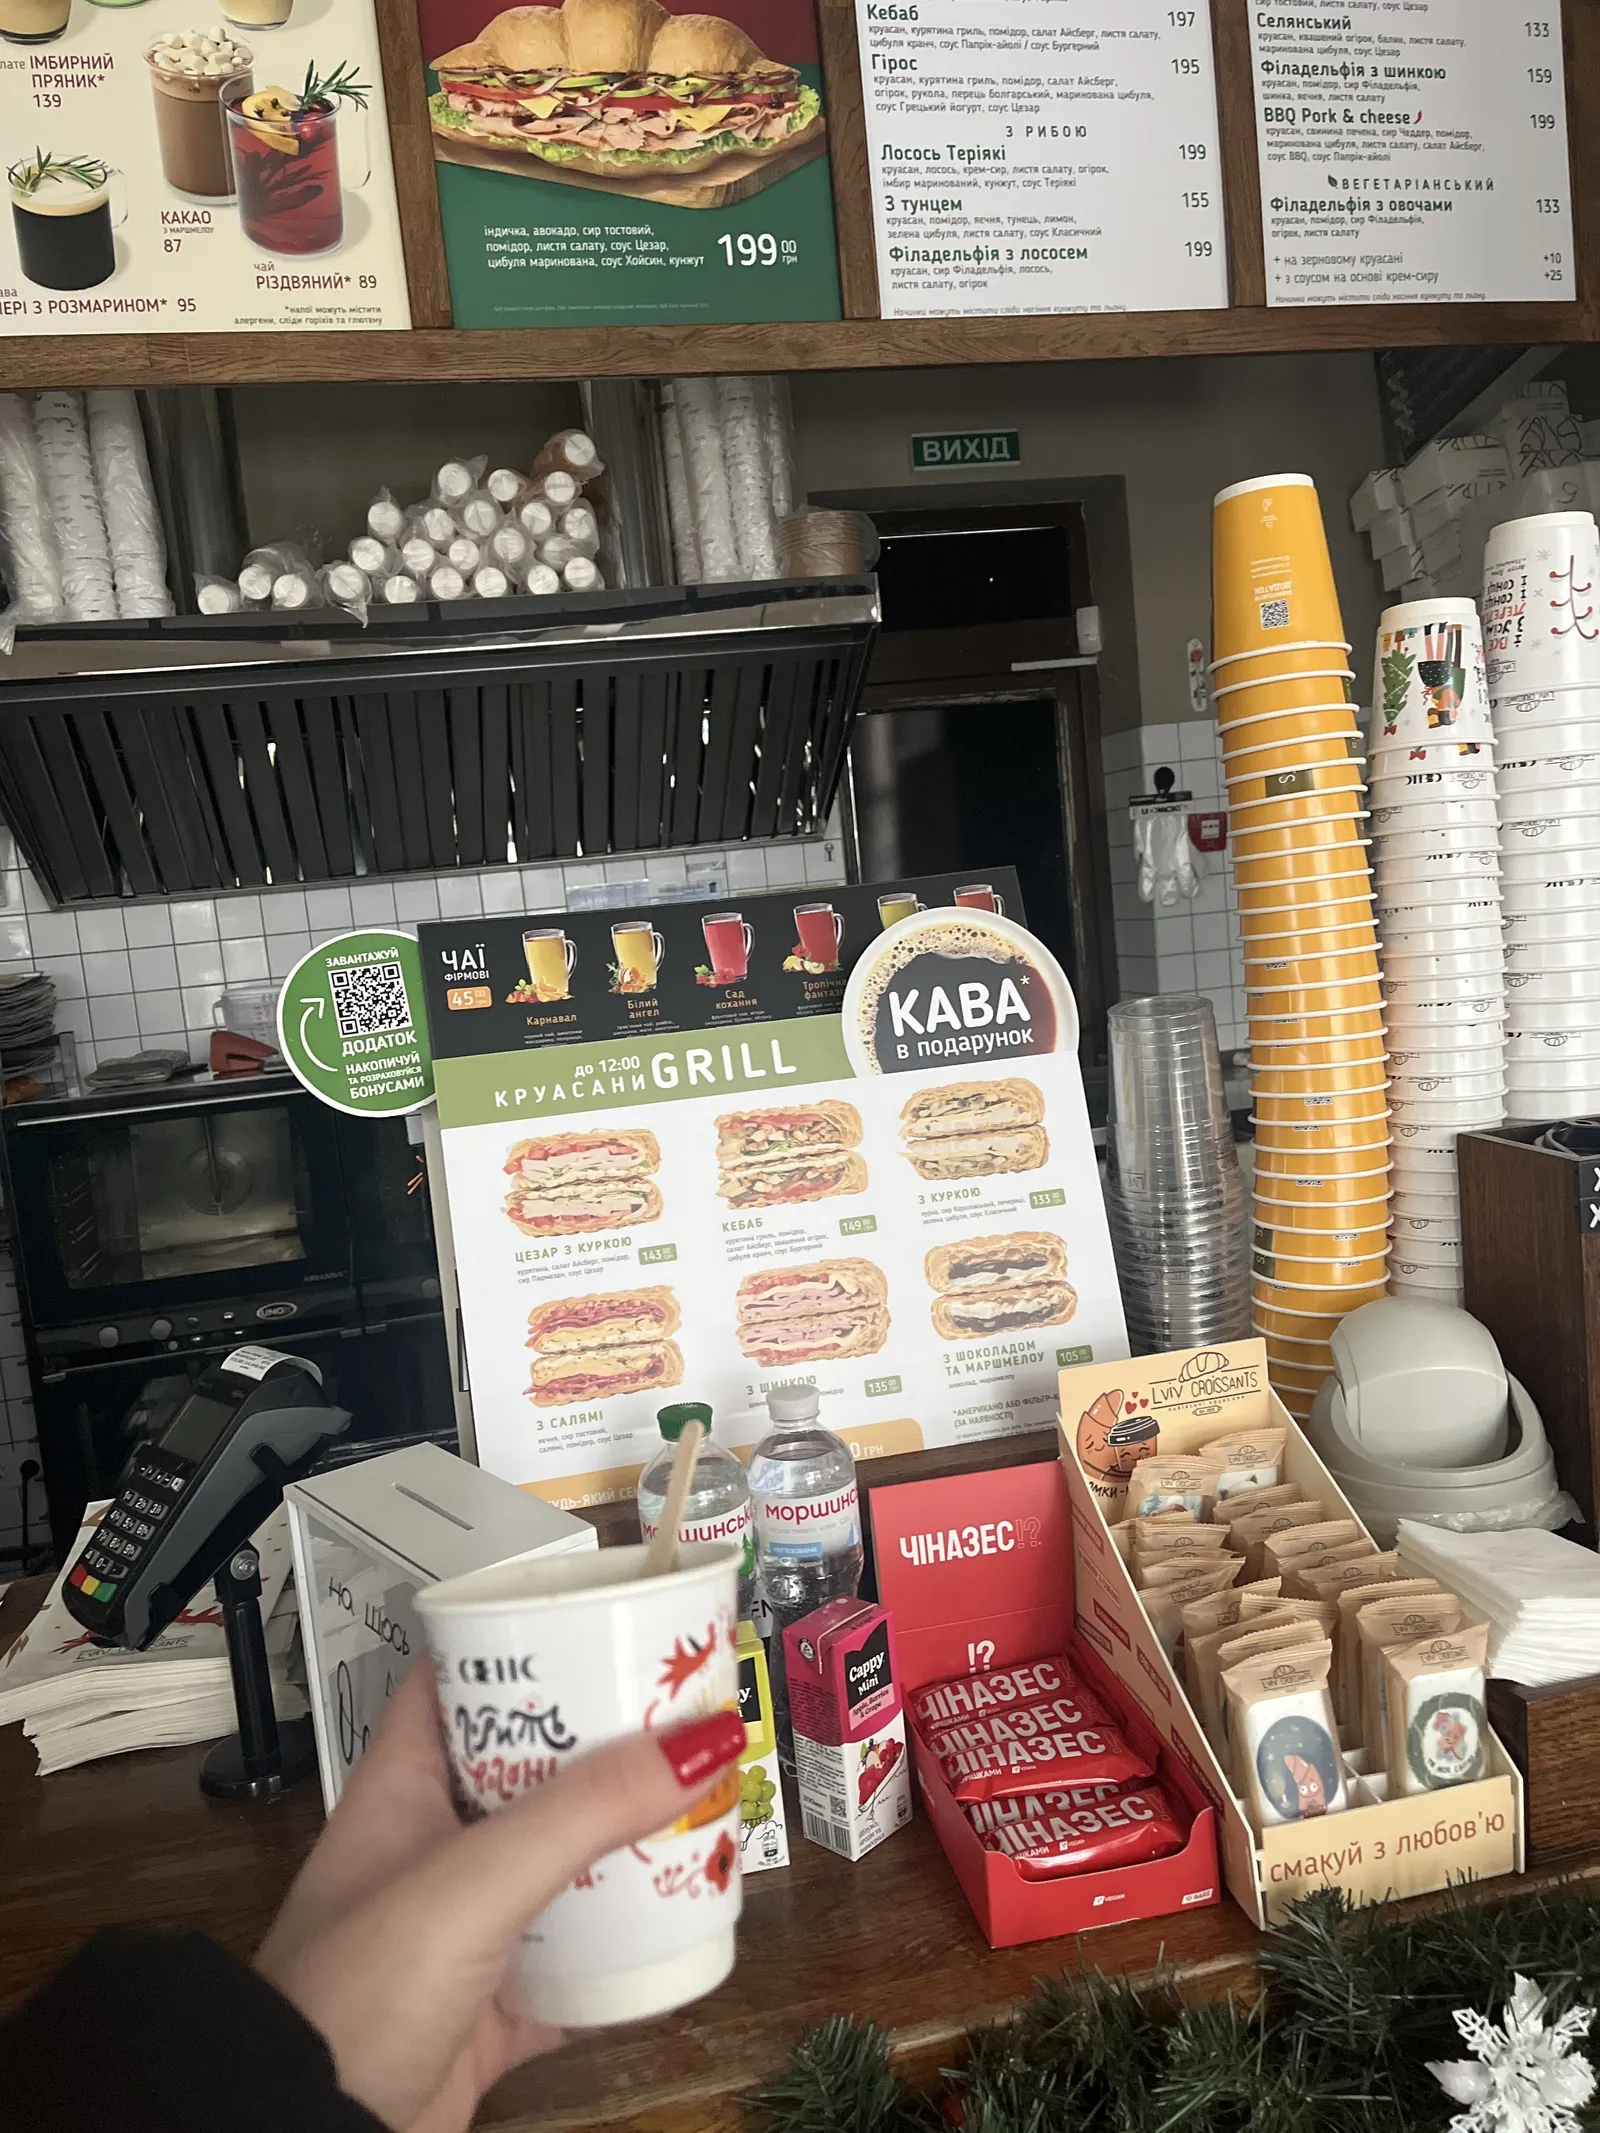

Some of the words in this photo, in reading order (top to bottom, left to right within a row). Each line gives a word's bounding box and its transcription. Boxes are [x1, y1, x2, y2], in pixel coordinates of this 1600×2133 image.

[867, 5, 919, 21] Кебаб
[1167, 11, 1196, 26] 197
[1256, 12, 1352, 30] Селянський
[868, 25, 908, 38] круасан,
[910, 26, 954, 37] курятина
[956, 27, 986, 37] гриль,
[988, 26, 1029, 40] помідор,
[1031, 28, 1056, 36] салат
[1059, 27, 1098, 39] Айсберг,
[1100, 30, 1126, 38] листя
[1128, 30, 1160, 41] салату,
[1524, 22, 1550, 38] 133
[30, 52, 114, 70] ІМБИРНИЙ
[872, 54, 919, 74] Гірос
[1171, 58, 1200, 74] 195
[1260, 60, 1364, 80] Філадельфія
[1370, 66, 1378, 78] з
[1384, 66, 1446, 80] шинкою
[1527, 68, 1552, 84] 159
[873, 75, 915, 86] круасан,
[918, 76, 964, 86] курятина
[966, 77, 998, 87] гриль,
[1001, 75, 1044, 88] помідор,
[1046, 77, 1074, 86] салат
[1077, 75, 1118, 88] Айсберг,
[33, 94, 62, 108] 139
[1264, 107, 1296, 126] BBQ
[1302, 108, 1337, 124] Pork
[1342, 109, 1354, 124] &
[1360, 109, 1411, 124] cheese
[1530, 114, 1556, 130] 199
[1006, 126, 1013, 138] З
[1026, 126, 1088, 138] РИБОЮ
[882, 144, 942, 161] Лосось
[946, 144, 1006, 164] Теріякі
[1178, 144, 1206, 160] 199
[1342, 177, 1495, 191] ВЕГЕТАРІАНСЬКИЙ
[884, 196, 894, 212] З
[900, 197, 963, 214] тунцем
[1182, 192, 1210, 208] 155
[1270, 196, 1371, 216] Філадельфія
[1376, 200, 1384, 212] з
[1389, 200, 1453, 212] овочами
[1536, 199, 1560, 214] 133
[160, 210, 212, 225] КАКАО
[484, 224, 529, 238] індичка,
[532, 226, 579, 237] авокадо,
[582, 226, 601, 238] сир
[604, 224, 654, 236] тостовий,
[164, 239, 182, 252] 87
[486, 240, 532, 254] помідор,
[536, 242, 566, 251] листя
[569, 242, 607, 253] салату,
[610, 241, 632, 253] соус
[634, 239, 668, 252] Цезар,
[717, 233, 778, 266] 199
[781, 240, 797, 254] 00
[1184, 242, 1212, 257] 199
[487, 255, 526, 269] цибуля
[529, 257, 598, 269] маринована,
[600, 256, 622, 268] соус
[625, 254, 666, 266] Хойсин,
[668, 256, 704, 268] кунжут
[782, 254, 798, 264] грн
[889, 246, 1000, 266] Філадельфія
[1006, 248, 1014, 260] з
[1020, 246, 1088, 260] лососем
[1544, 252, 1562, 264] +10
[254, 260, 275, 272] чай
[358, 274, 378, 289] 89
[176, 298, 197, 312] 95
[922, 436, 1010, 462] ВИХІД
[324, 946, 400, 968] ЗАВАНТАЖУЙ
[441, 943, 487, 971] ЧАЇ
[444, 970, 490, 983] ФІРМОВІ
[452, 990, 474, 1008] 45
[725, 990, 746, 1001] Сад
[626, 998, 660, 1010] Білий
[715, 998, 758, 1010] кохання
[526, 1012, 578, 1027] Карнавал
[629, 1008, 660, 1020] ангел
[341, 1029, 418, 1058] ДОДАТОК
[896, 1042, 910, 1060] в
[917, 1027, 1035, 1058] подарунок
[344, 1050, 422, 1076] НАКОПИЧУЙ
[574, 1064, 594, 1080] до
[598, 1056, 641, 1075] 12:00
[651, 1038, 798, 1090] GRILL
[348, 1075, 358, 1085] ТА
[360, 1064, 423, 1083] РОЗРАХОВУЙСЯ
[348, 1074, 426, 1100] БОНУСАМИ
[494, 1075, 647, 1108] КРУАСАНИ
[931, 1187, 981, 1202] КУРКОЮ
[1032, 1194, 1051, 1205] 133
[722, 1217, 764, 1232] КЕБАБ
[842, 1220, 862, 1232] 149
[515, 1247, 559, 1264] ЦЕЗАР
[578, 1236, 632, 1254] КУРКОЮ
[642, 1250, 662, 1262] 143
[956, 1340, 1036, 1362] ШОКОЛАДОМ
[1060, 1352, 1078, 1362] 105
[946, 1365, 960, 1376] ТА
[966, 1352, 1045, 1374] МАРШМЕЛОУ
[868, 1382, 888, 1394] 135
[550, 1410, 604, 1428] САЛЯМІ
[864, 1444, 884, 1457] ГРН
[967, 1640, 996, 1674] !?
[849, 1652, 884, 1683] Cappy
[858, 1674, 880, 1696] Mini
[1270, 1844, 1363, 1883] смакуй
[1374, 1838, 1388, 1856] з
[1396, 1812, 1506, 1856] любов'ю
